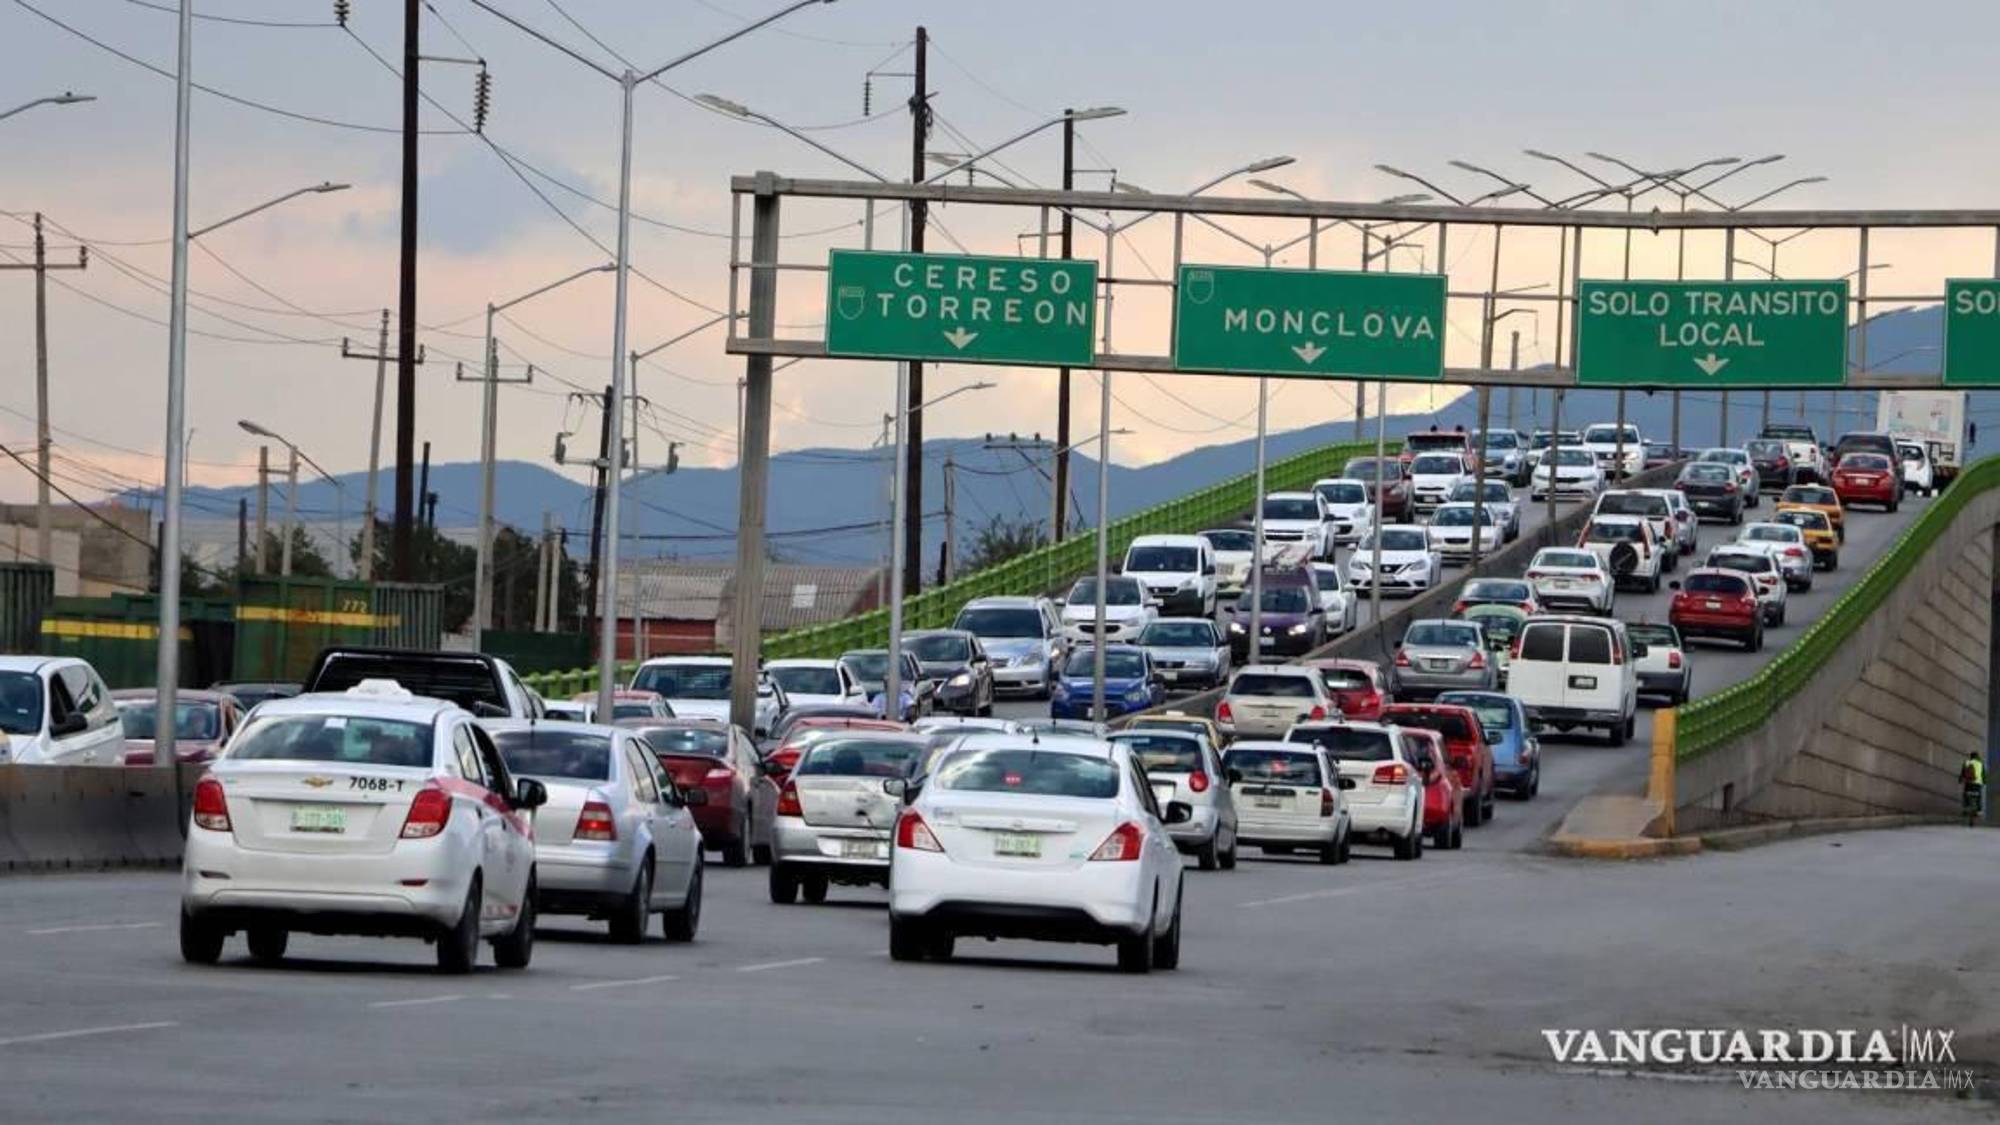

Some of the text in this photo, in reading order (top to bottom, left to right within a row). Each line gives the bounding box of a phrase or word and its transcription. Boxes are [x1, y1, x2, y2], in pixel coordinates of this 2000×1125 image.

[894, 263, 1071, 294] CERESO
[877, 293, 1086, 325] TORREON
[1589, 291, 1838, 316] SOLO TRANSITO
[1956, 290, 2000, 314] SO
[1224, 308, 1434, 340] MONCLOVA
[1660, 322, 1764, 346] LOCAL
[349, 775, 405, 793] 7068-T
